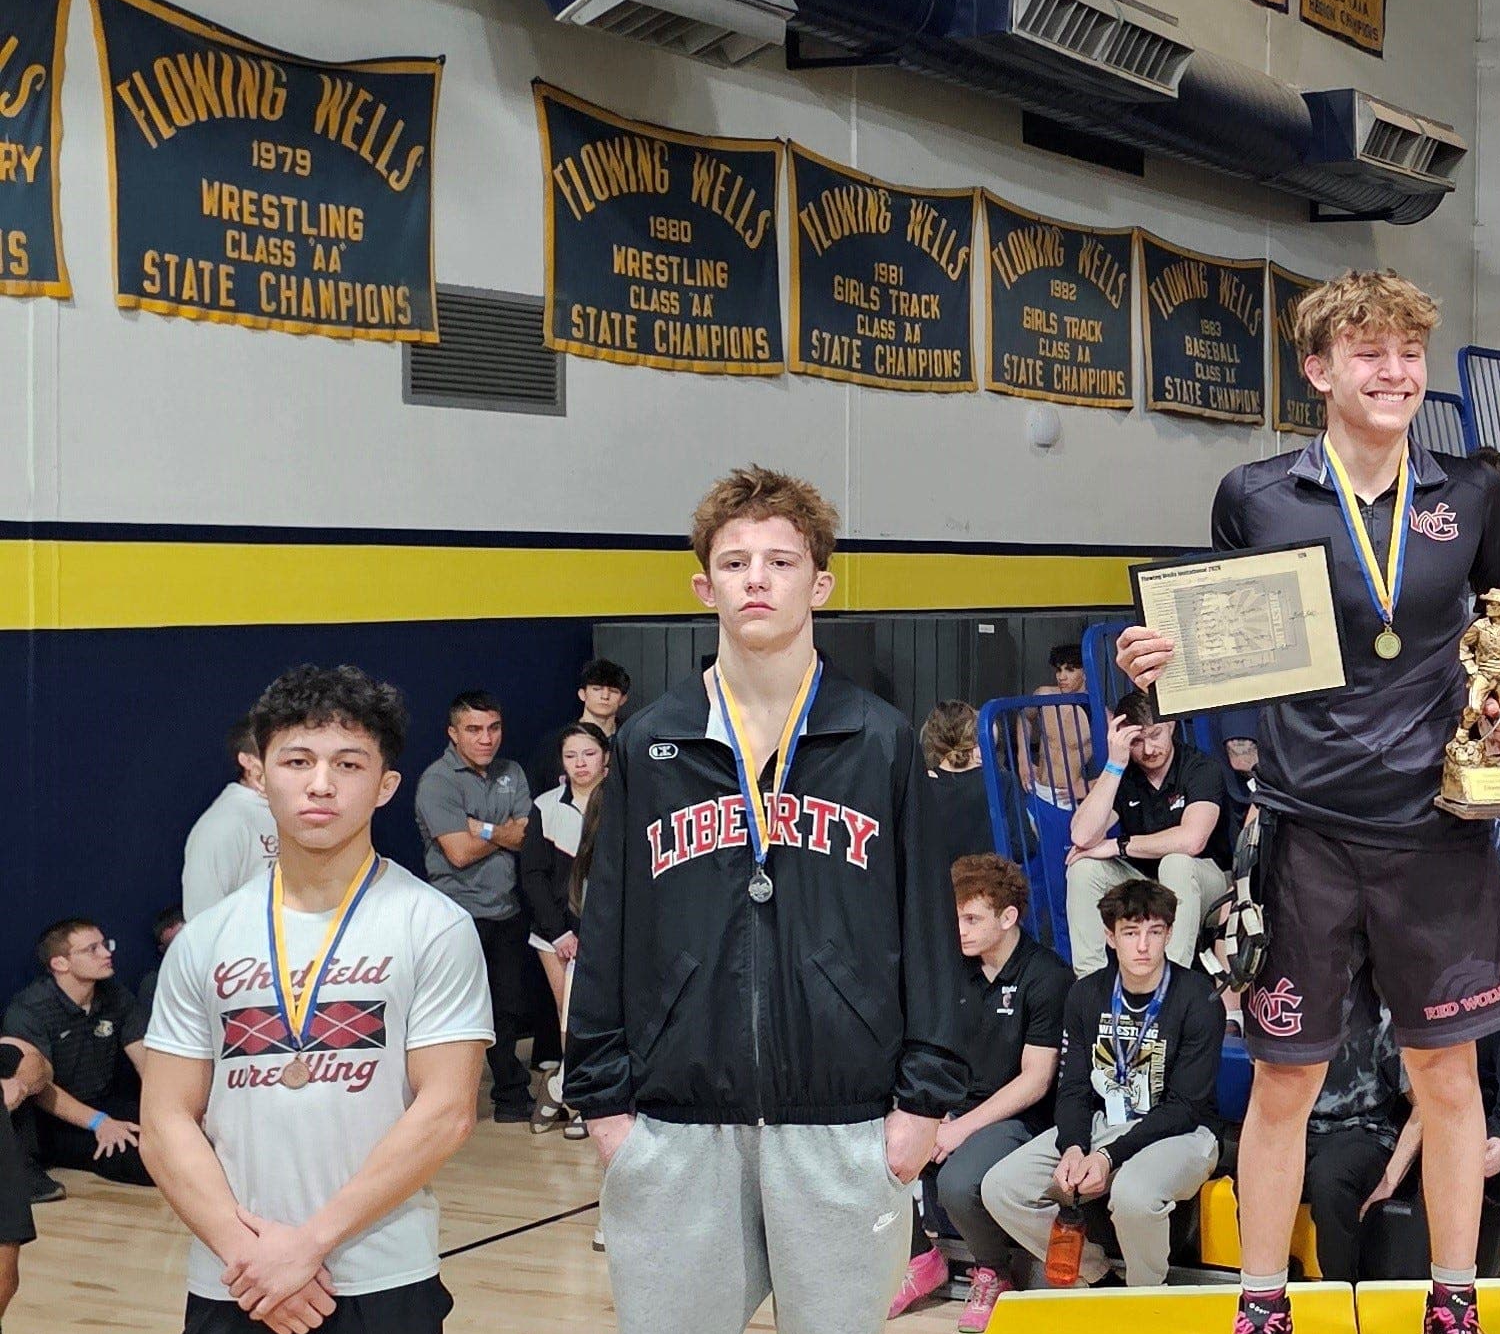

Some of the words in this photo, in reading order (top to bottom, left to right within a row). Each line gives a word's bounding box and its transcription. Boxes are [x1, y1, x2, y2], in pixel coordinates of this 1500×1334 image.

[116, 51, 287, 150] FLOWING
[314, 74, 425, 193] WELLS
[251, 139, 312, 177] 1979
[201, 177, 364, 242] WRESTLING
[553, 135, 669, 221] FLOWING
[691, 151, 771, 251] WELLS
[225, 229, 296, 268] CLASS
[649, 215, 692, 243] 1980
[799, 186, 892, 257] FLOWING
[905, 198, 971, 282] WELLS
[613, 243, 728, 288] WRESTLING
[873, 263, 904, 285] 1981
[992, 225, 1065, 290] FLOWING
[1078, 234, 1128, 309] WELLS
[142, 250, 237, 309] STATE
[260, 271, 412, 325] CHAMPIONS
[629, 285, 680, 317] CLASS
[834, 275, 880, 311] GIRLS
[889, 290, 940, 319] TRACK
[1050, 279, 1077, 301] 1982
[1150, 260, 1208, 320] FLOWING
[1219, 268, 1262, 336] WELLS
[571, 303, 638, 349] STATE
[654, 319, 770, 360] CHAMPIONS
[856, 315, 896, 340] CLASS
[1022, 305, 1058, 334] GIRLS
[1063, 315, 1103, 343] TRACK
[811, 329, 861, 369] STATE
[874, 342, 961, 378] CHAMPIONS
[1039, 337, 1070, 362] CLASS
[1077, 346, 1092, 364] AA
[1185, 335, 1240, 363] BASEBALL
[1003, 353, 1044, 387] STATE
[1053, 363, 1125, 397] CHAMPIONS
[1195, 362, 1221, 381] CLASS
[1165, 376, 1202, 405] STATE
[1209, 386, 1261, 413] CHAMPIONS
[1287, 399, 1310, 425] STATE
[646, 793, 881, 879] LIBERTY
[214, 956, 393, 1001] Chatield
[1423, 1002, 1459, 1021] RED
[227, 1053, 380, 1093] wretling
